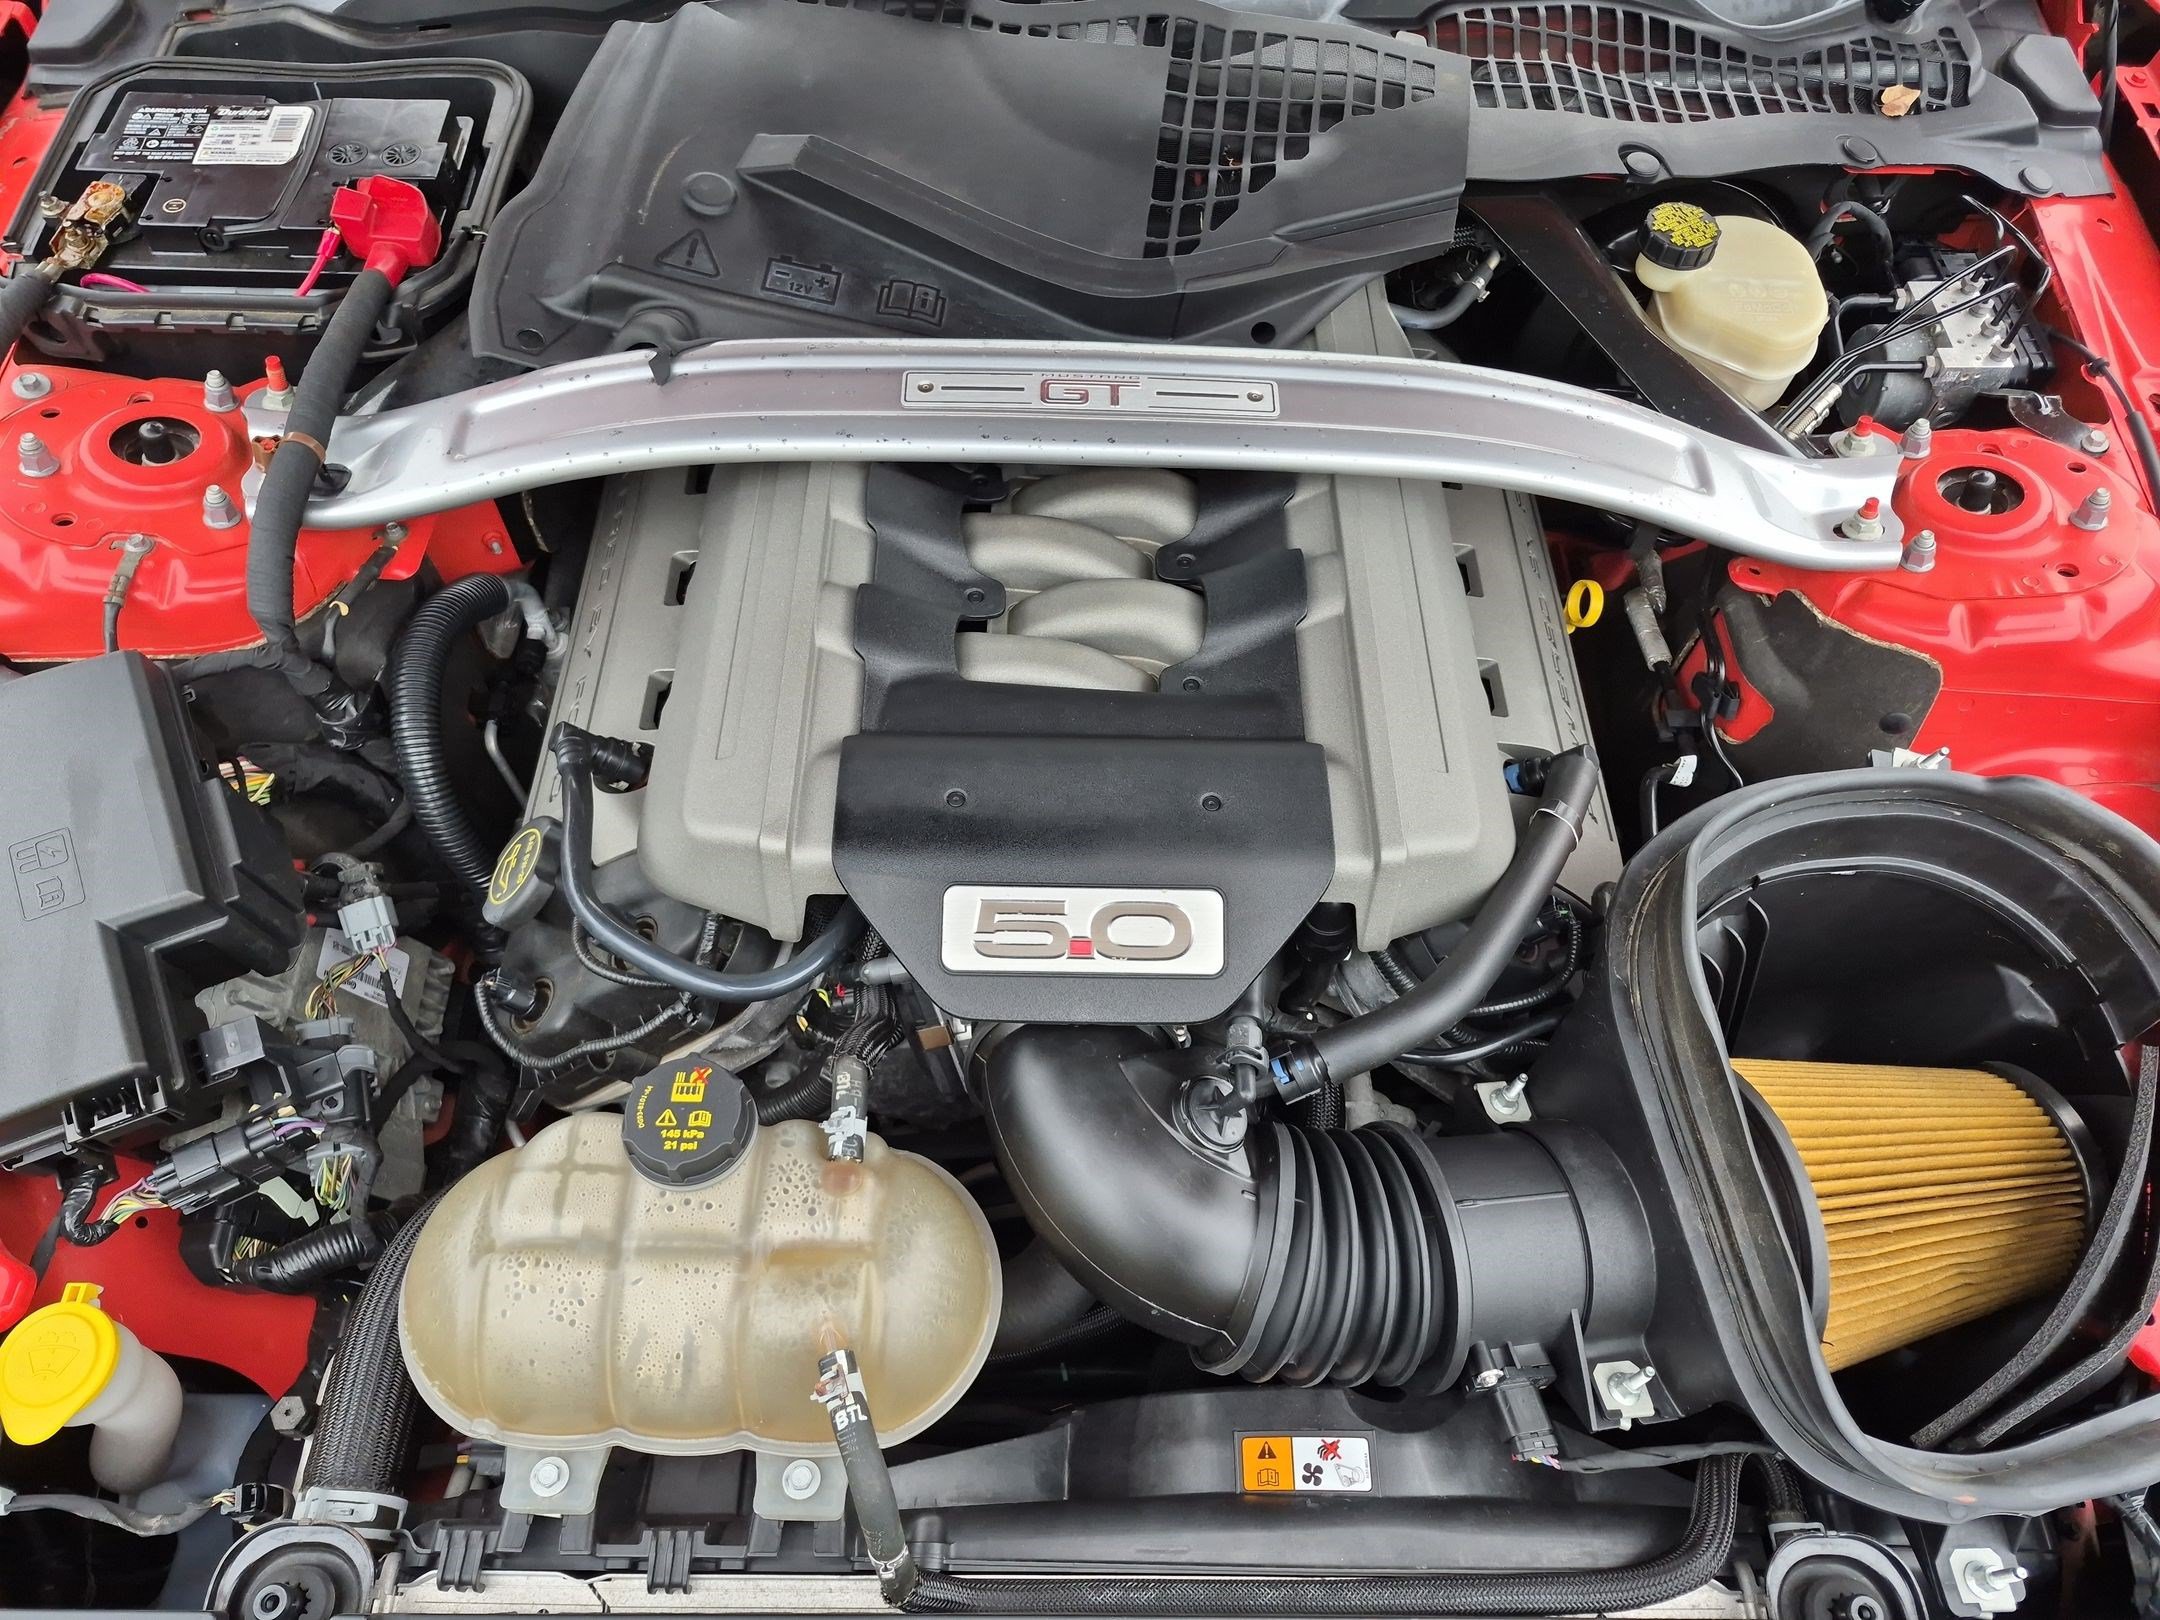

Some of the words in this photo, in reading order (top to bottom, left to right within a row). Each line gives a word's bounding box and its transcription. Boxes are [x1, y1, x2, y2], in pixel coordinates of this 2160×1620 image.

[217, 107, 271, 117] Duralast
[788, 281, 813, 295] 12V
[1040, 379, 1141, 408] GT
[973, 898, 1194, 961] 5.0
[660, 1129, 681, 1139] 145
[683, 1129, 705, 1139] kPa
[663, 1140, 678, 1151] 21
[680, 1140, 698, 1152] psi
[834, 1403, 868, 1431] BTL
